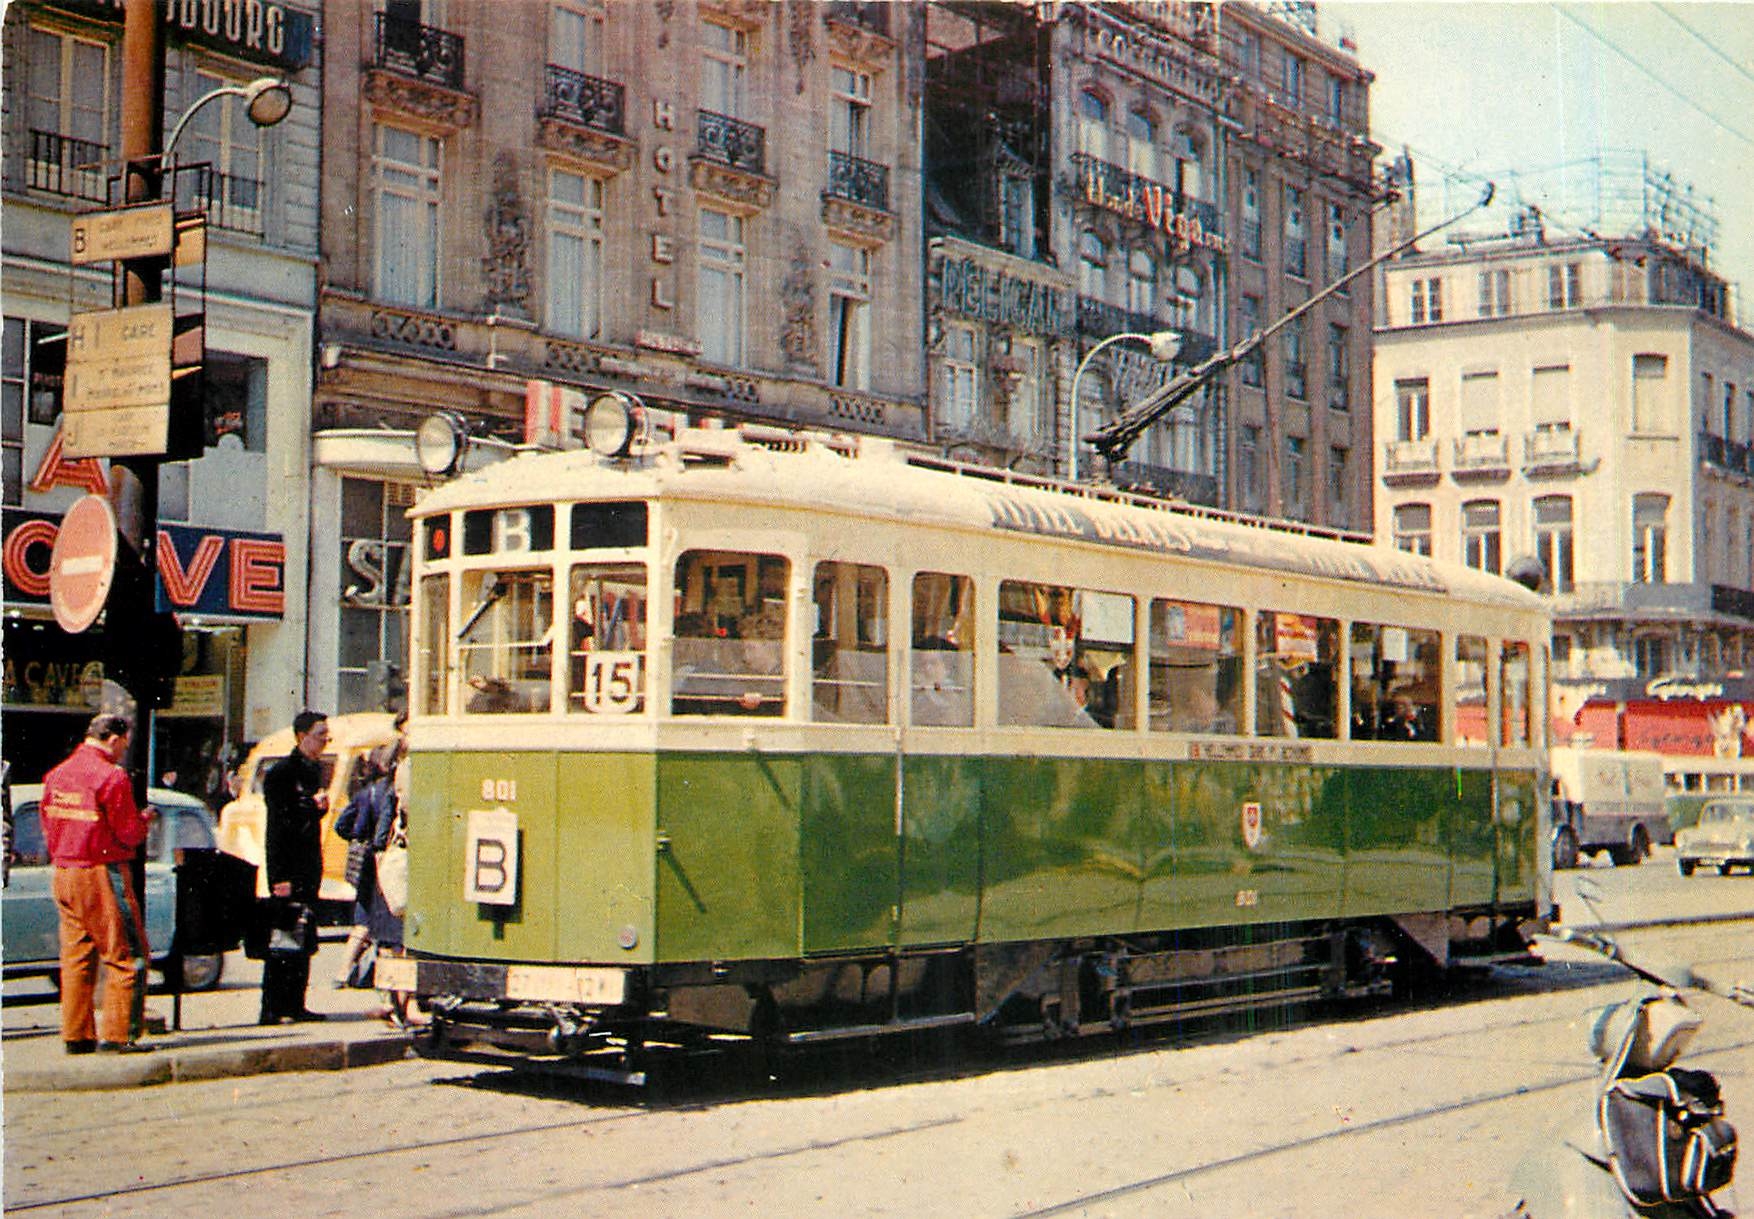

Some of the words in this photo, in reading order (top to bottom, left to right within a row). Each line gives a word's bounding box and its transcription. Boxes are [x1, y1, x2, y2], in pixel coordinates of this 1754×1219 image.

[653, 98, 674, 310] HOTEL
[75, 228, 86, 253] B
[493, 509, 531, 552] B
[3, 519, 287, 613] CVE
[592, 661, 632, 704] 15
[481, 779, 517, 801] 801
[475, 838, 507, 893] B
